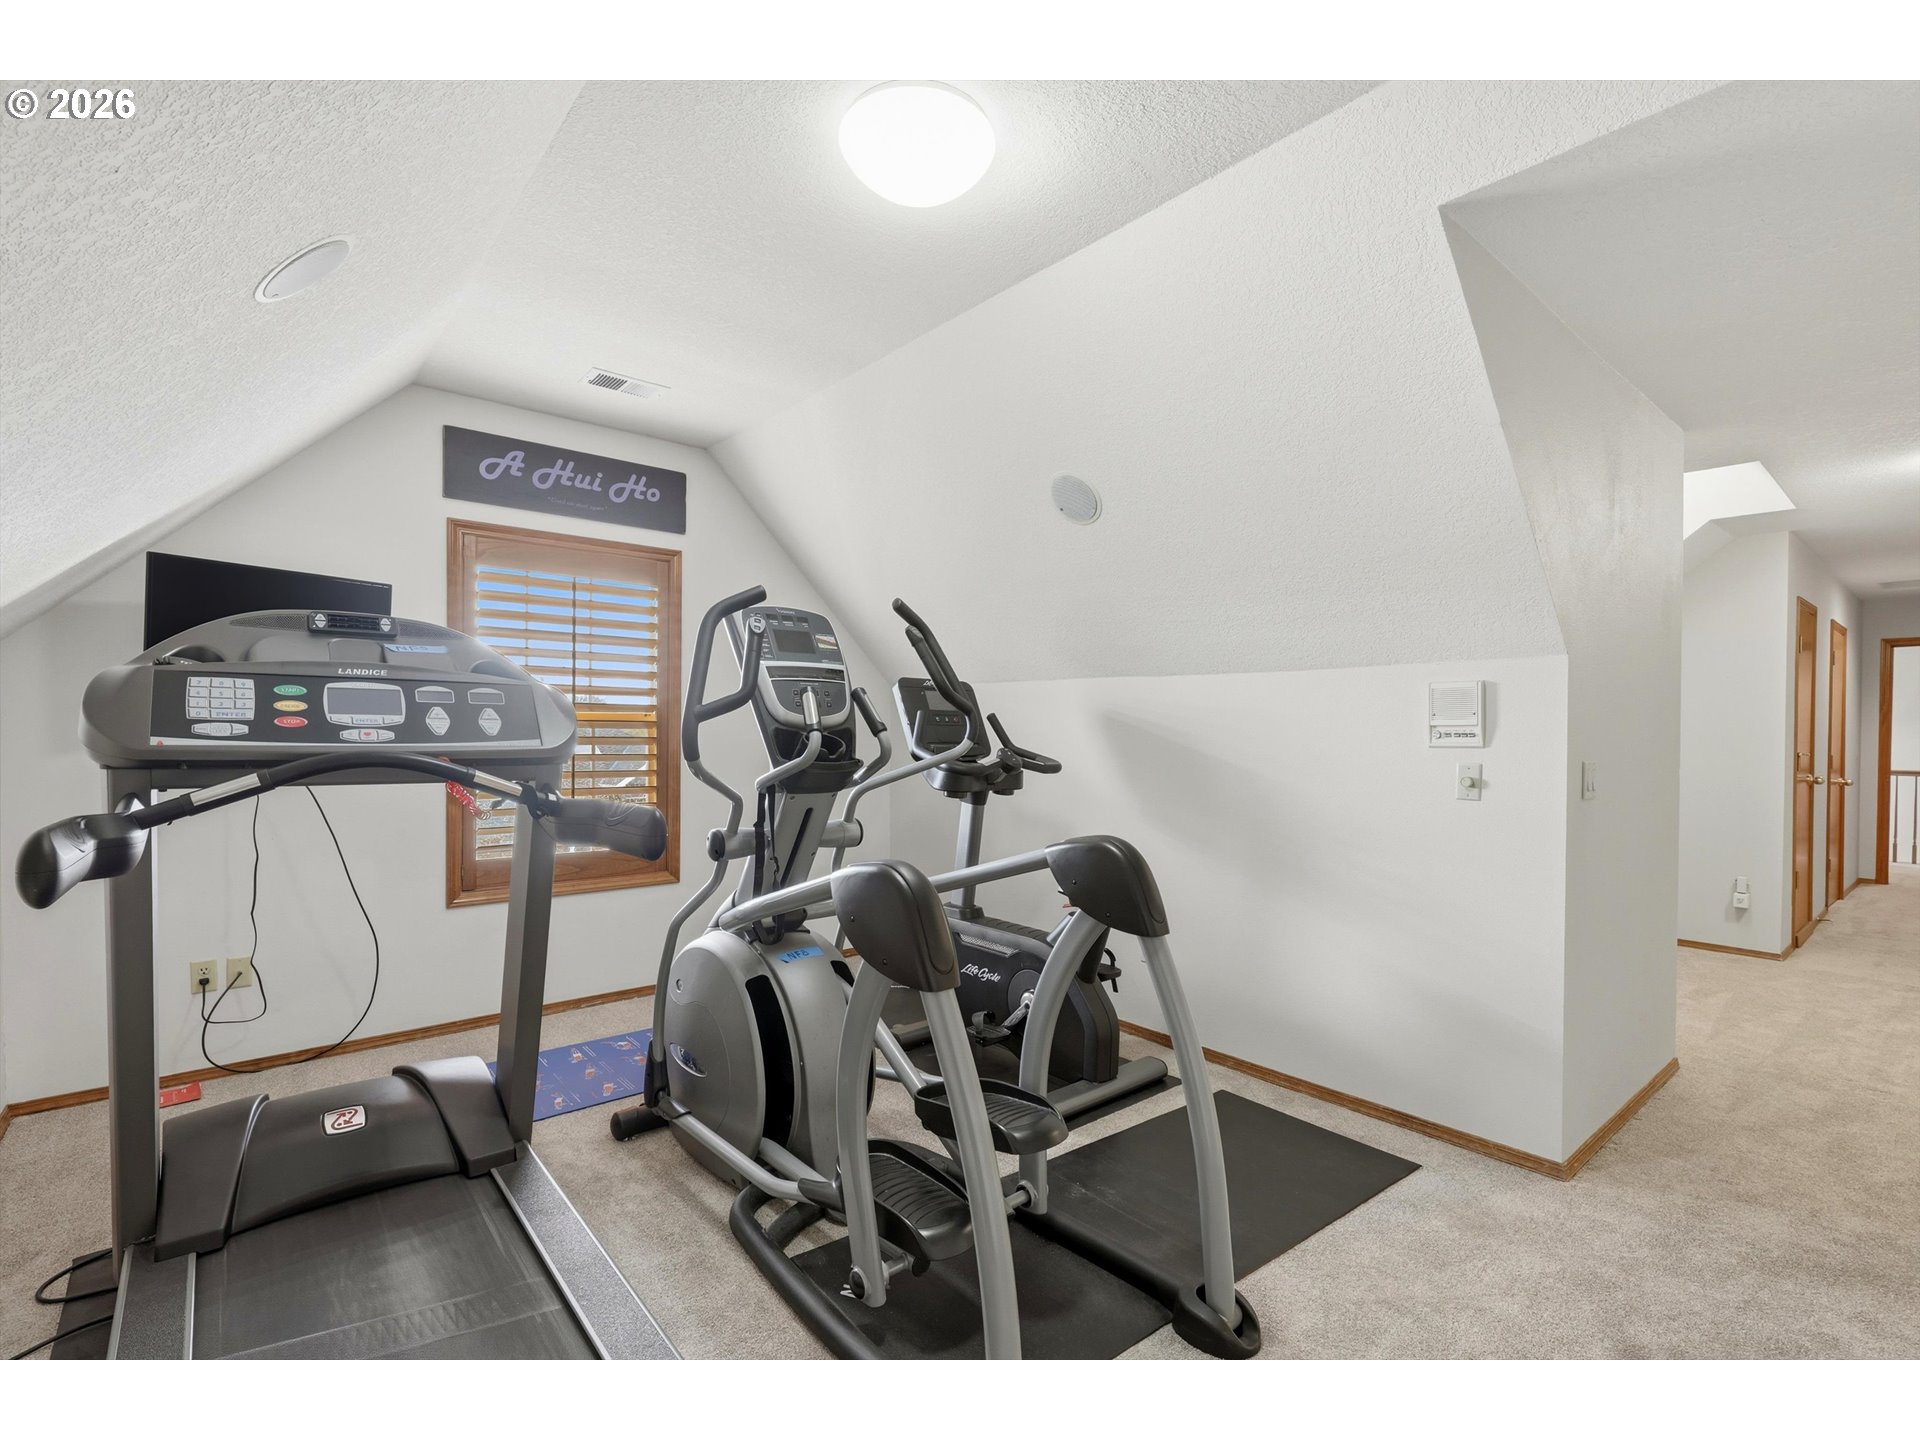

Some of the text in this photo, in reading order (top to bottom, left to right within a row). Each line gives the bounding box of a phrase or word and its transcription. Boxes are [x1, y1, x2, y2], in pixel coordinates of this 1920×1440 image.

[479, 450, 661, 503] A Hui Ho
[338, 667, 388, 676] LANDICE
[960, 963, 1002, 982] Life Cycle
